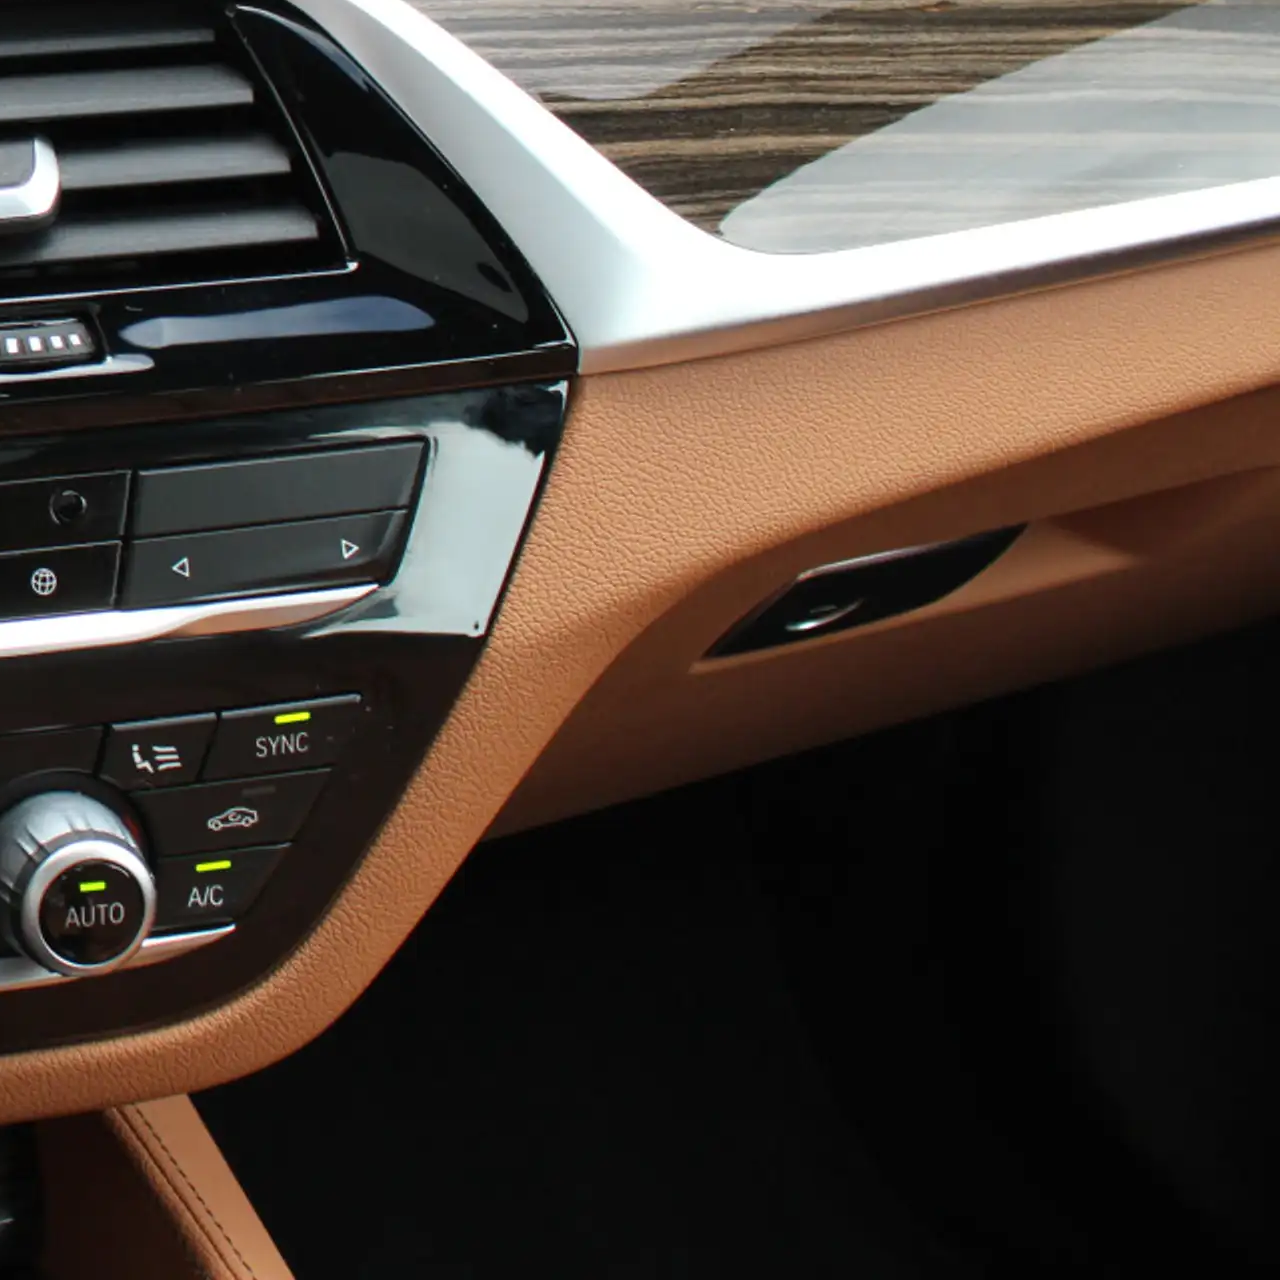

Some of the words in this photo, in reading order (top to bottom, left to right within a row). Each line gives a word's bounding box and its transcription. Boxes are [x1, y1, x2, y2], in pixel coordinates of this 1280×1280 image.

[254, 732, 310, 758] SYNC
[187, 884, 225, 909] A/C
[64, 901, 126, 929] AUTO
